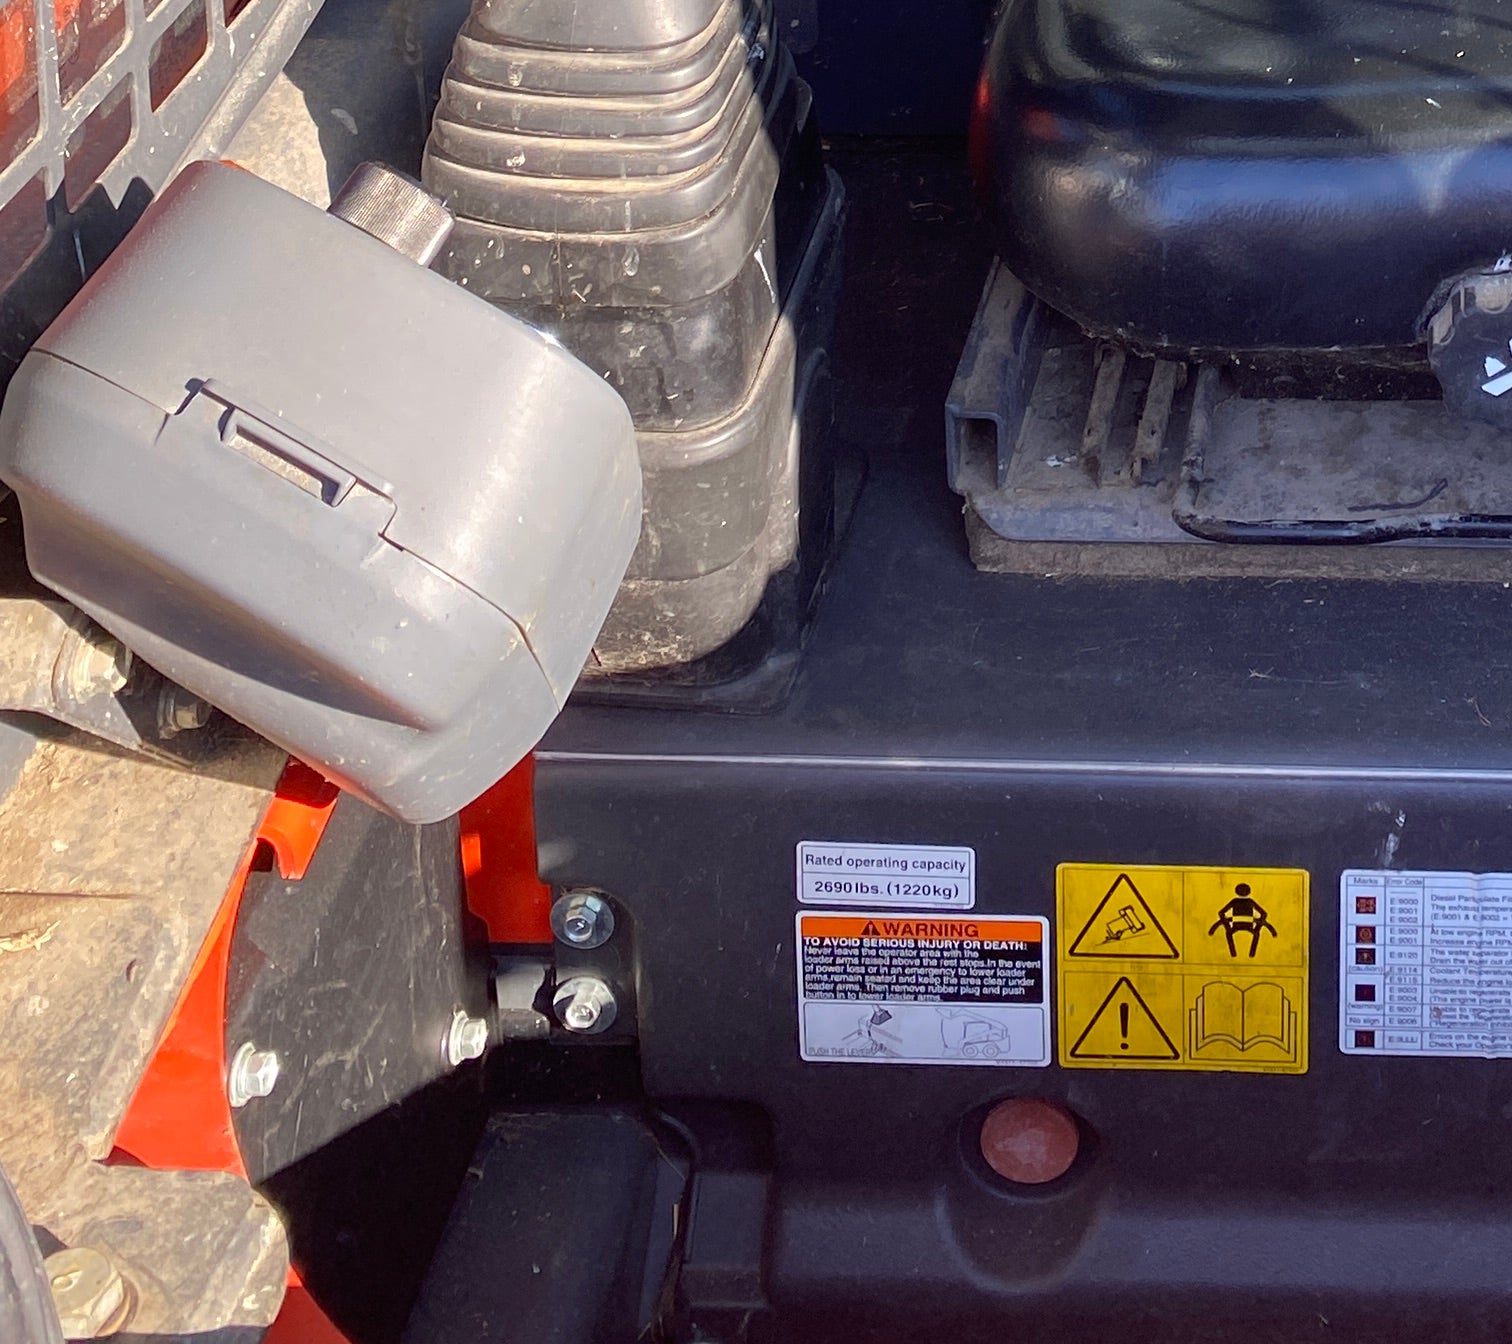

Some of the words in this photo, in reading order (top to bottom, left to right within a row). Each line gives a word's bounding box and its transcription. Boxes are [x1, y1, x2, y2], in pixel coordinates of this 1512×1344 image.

[805, 854, 842, 866] Rated
[847, 856, 908, 871] operating
[912, 859, 966, 872] capacity
[815, 881, 851, 893] 2690
[882, 921, 979, 937] WARNING
[804, 937, 820, 946] TO
[823, 938, 860, 946] AVOID
[863, 939, 914, 948] SERIOUS
[918, 940, 960, 949] INJURY
[963, 941, 980, 949] OR
